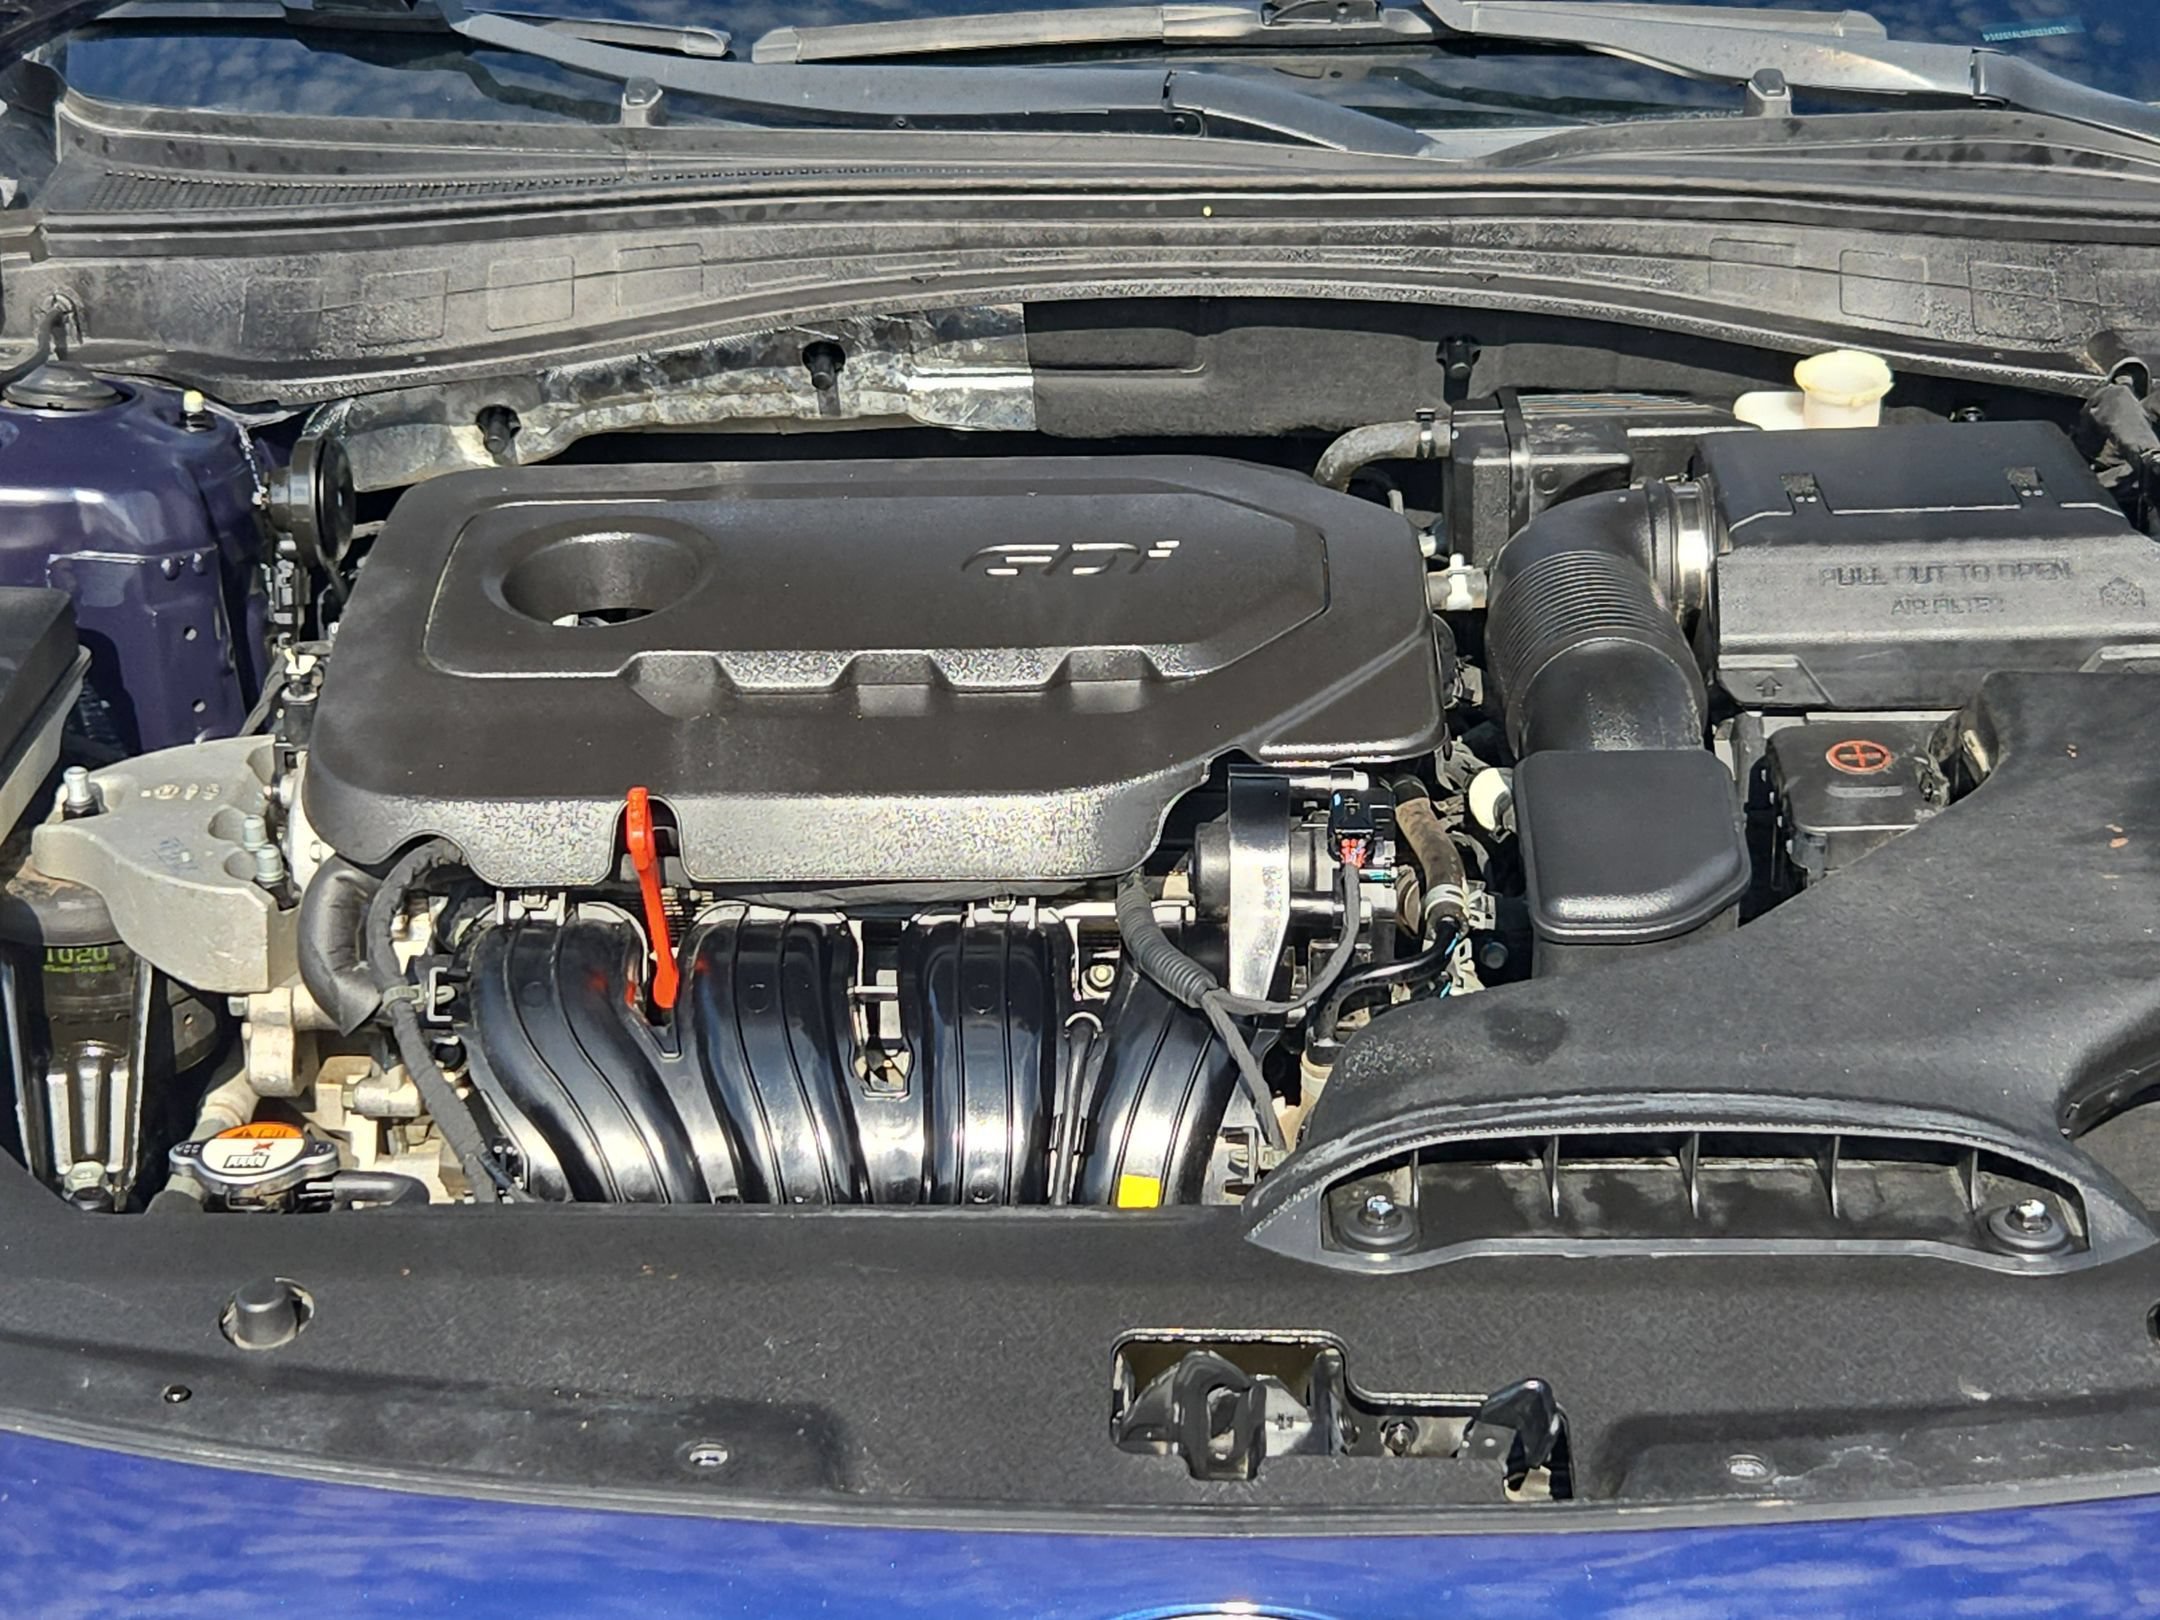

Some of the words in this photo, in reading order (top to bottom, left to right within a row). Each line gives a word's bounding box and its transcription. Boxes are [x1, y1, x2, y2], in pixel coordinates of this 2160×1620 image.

[1819, 562, 1888, 586] PULL
[1895, 561, 1948, 584] OUT
[1954, 561, 1992, 582] TO
[1998, 557, 2075, 582] OPEN
[1890, 595, 1928, 615] AIR
